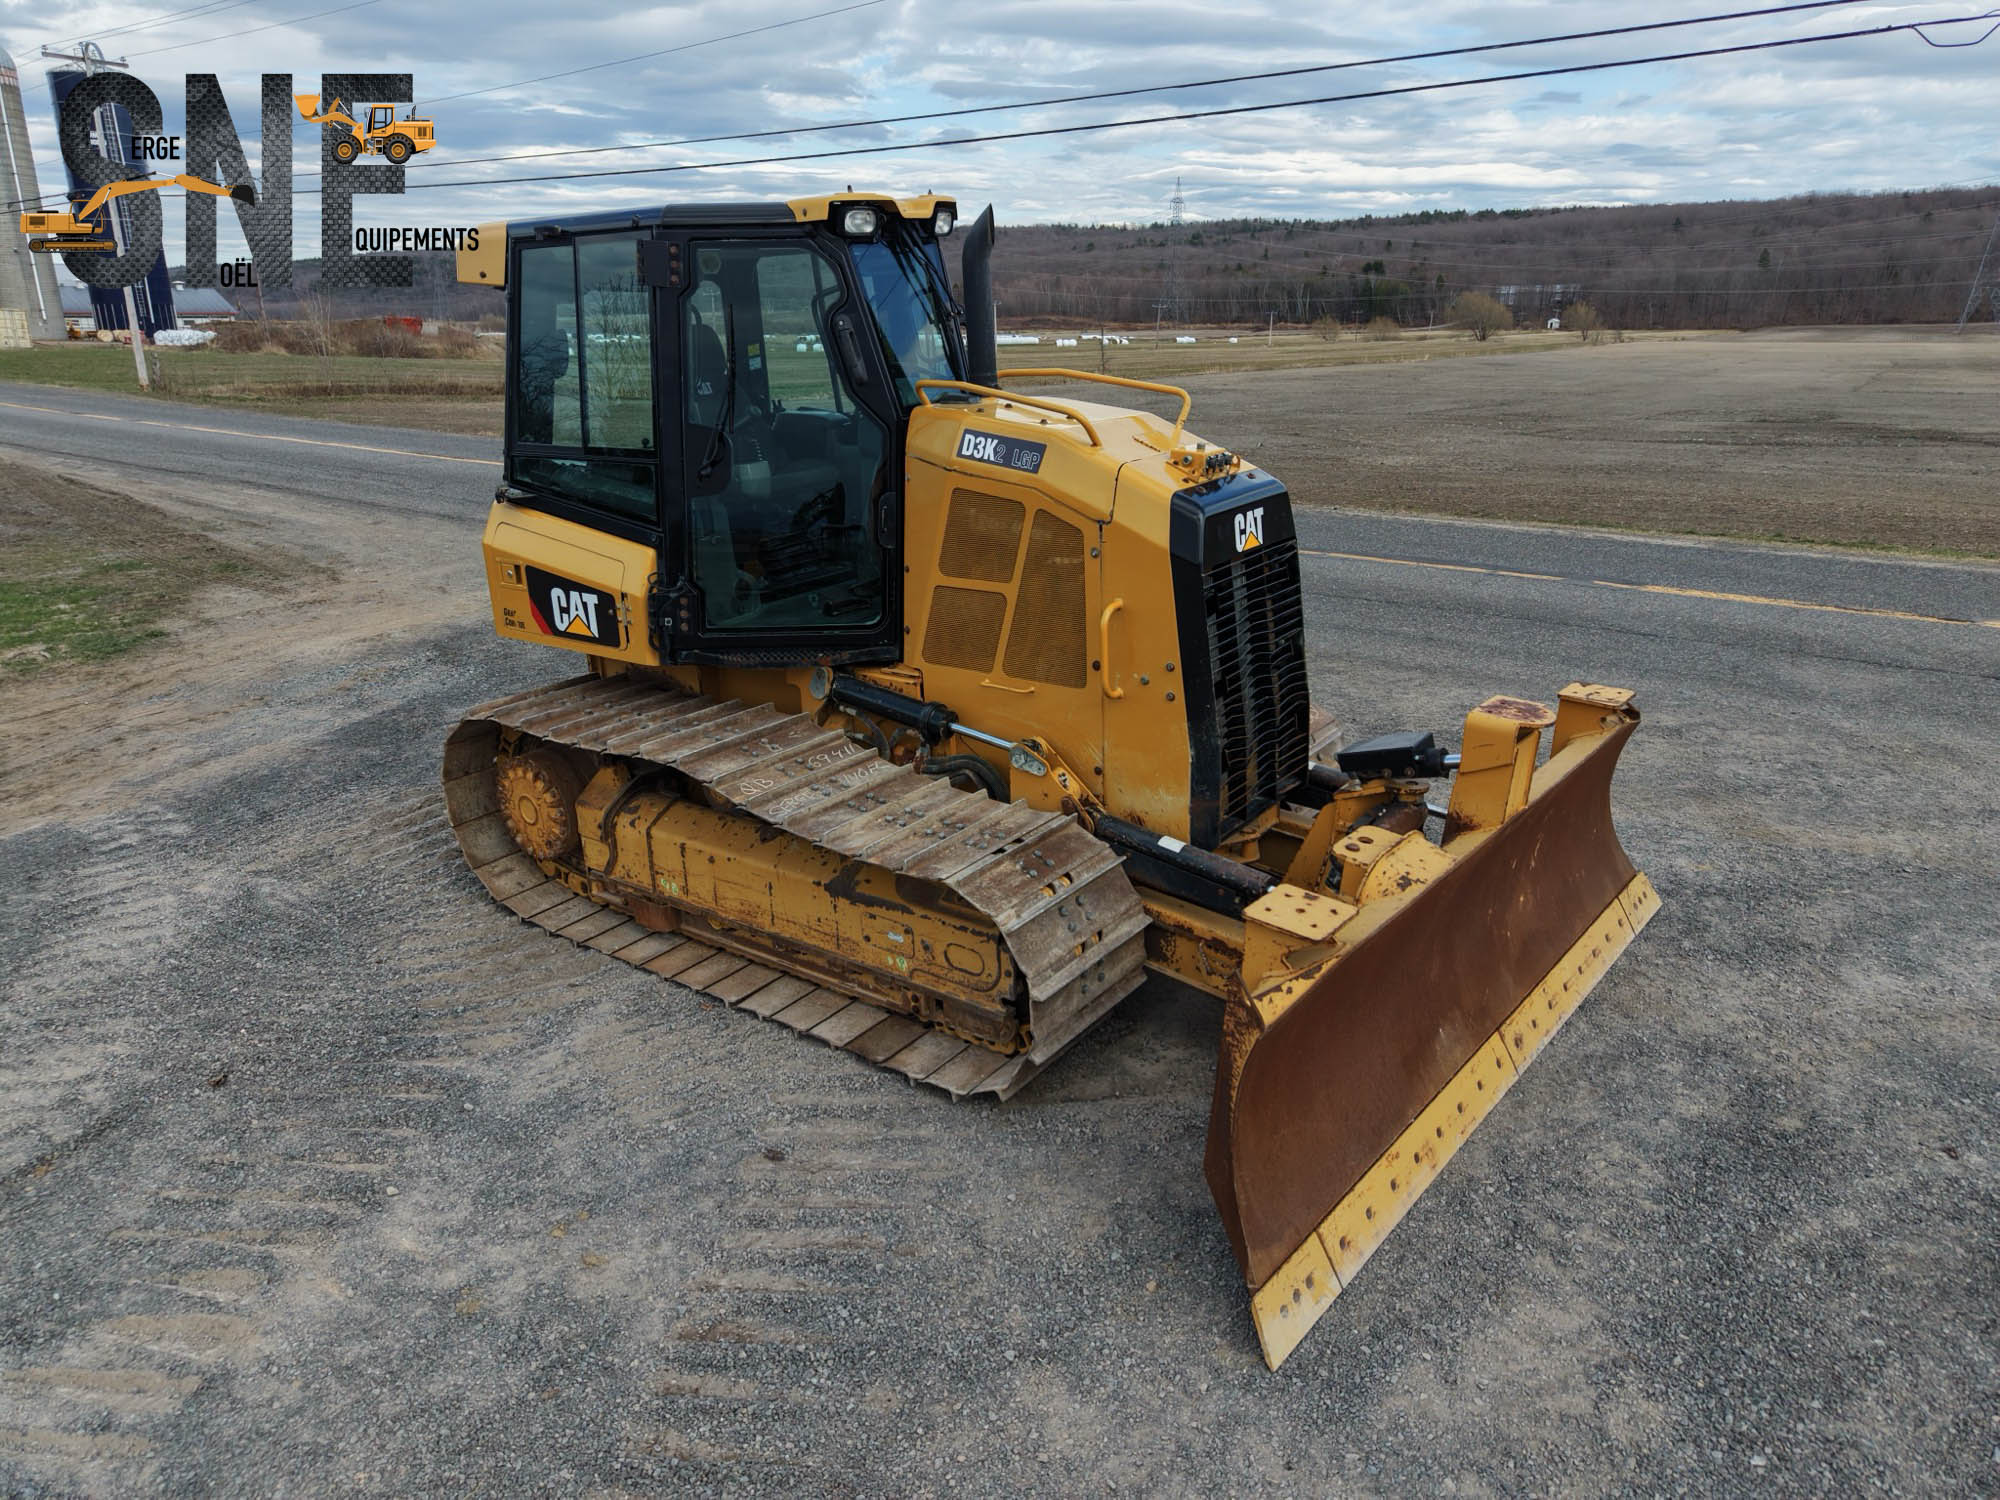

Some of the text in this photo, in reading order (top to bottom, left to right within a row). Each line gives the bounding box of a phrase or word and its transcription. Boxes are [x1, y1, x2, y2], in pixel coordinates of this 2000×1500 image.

[1011, 448, 1040, 470] LGP
[1234, 506, 1264, 553] CAT
[550, 587, 599, 639] CAT
